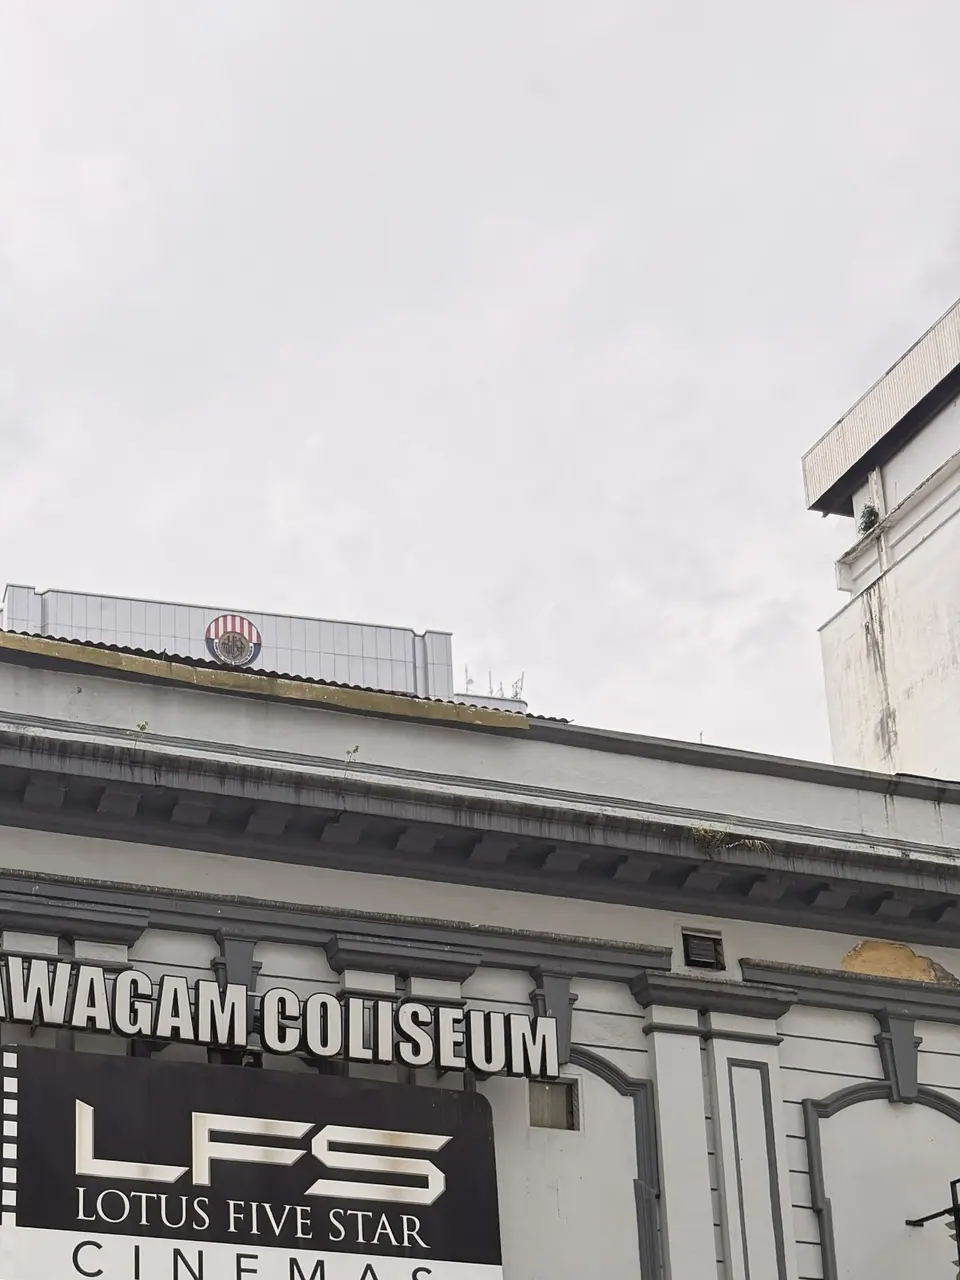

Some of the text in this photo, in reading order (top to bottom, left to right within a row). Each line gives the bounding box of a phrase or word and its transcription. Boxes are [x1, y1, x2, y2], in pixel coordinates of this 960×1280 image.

[259, 986, 560, 1081] COLISEUM
[75, 1098, 454, 1206] LFS
[75, 1186, 431, 1250] LOTUS FIVE STAR
